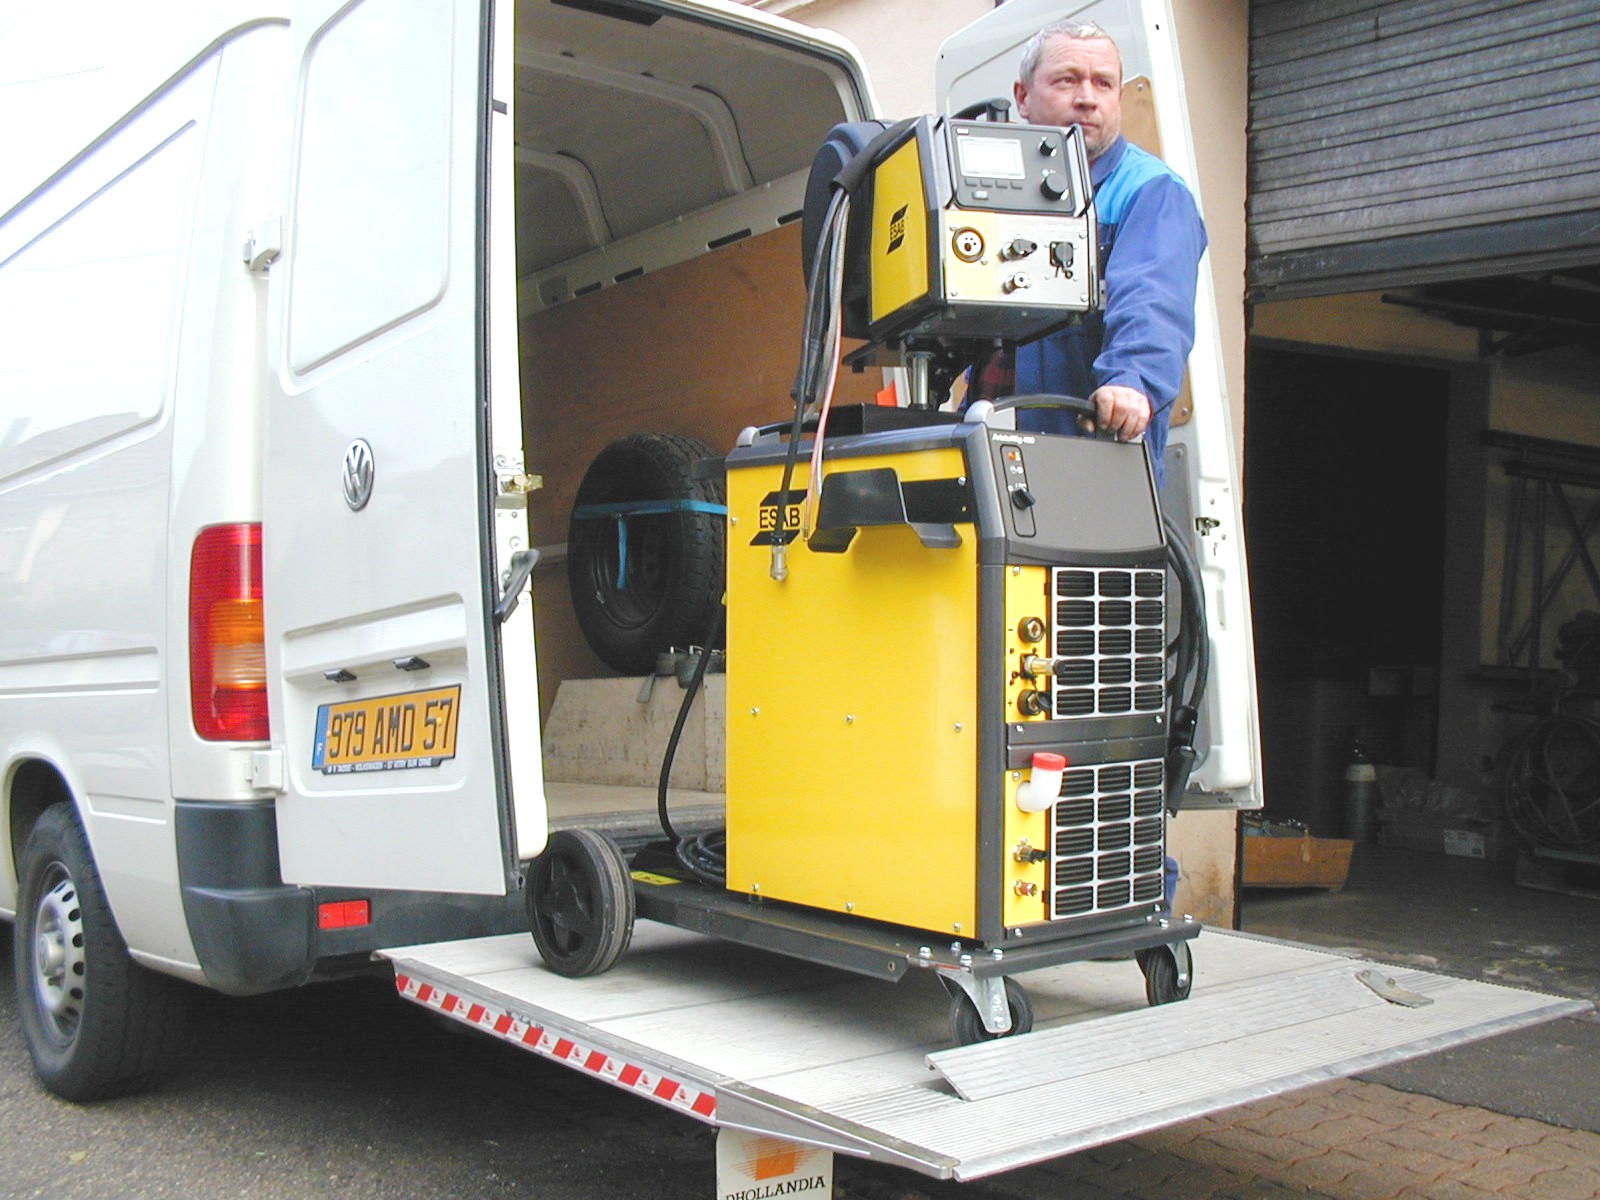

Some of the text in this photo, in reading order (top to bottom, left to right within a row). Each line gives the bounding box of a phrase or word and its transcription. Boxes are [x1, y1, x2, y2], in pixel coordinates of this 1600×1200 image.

[889, 219, 905, 241] ESAB
[329, 697, 453, 758] 979 AMD 57
[726, 1175, 826, 1200] DHOLLANDIA
